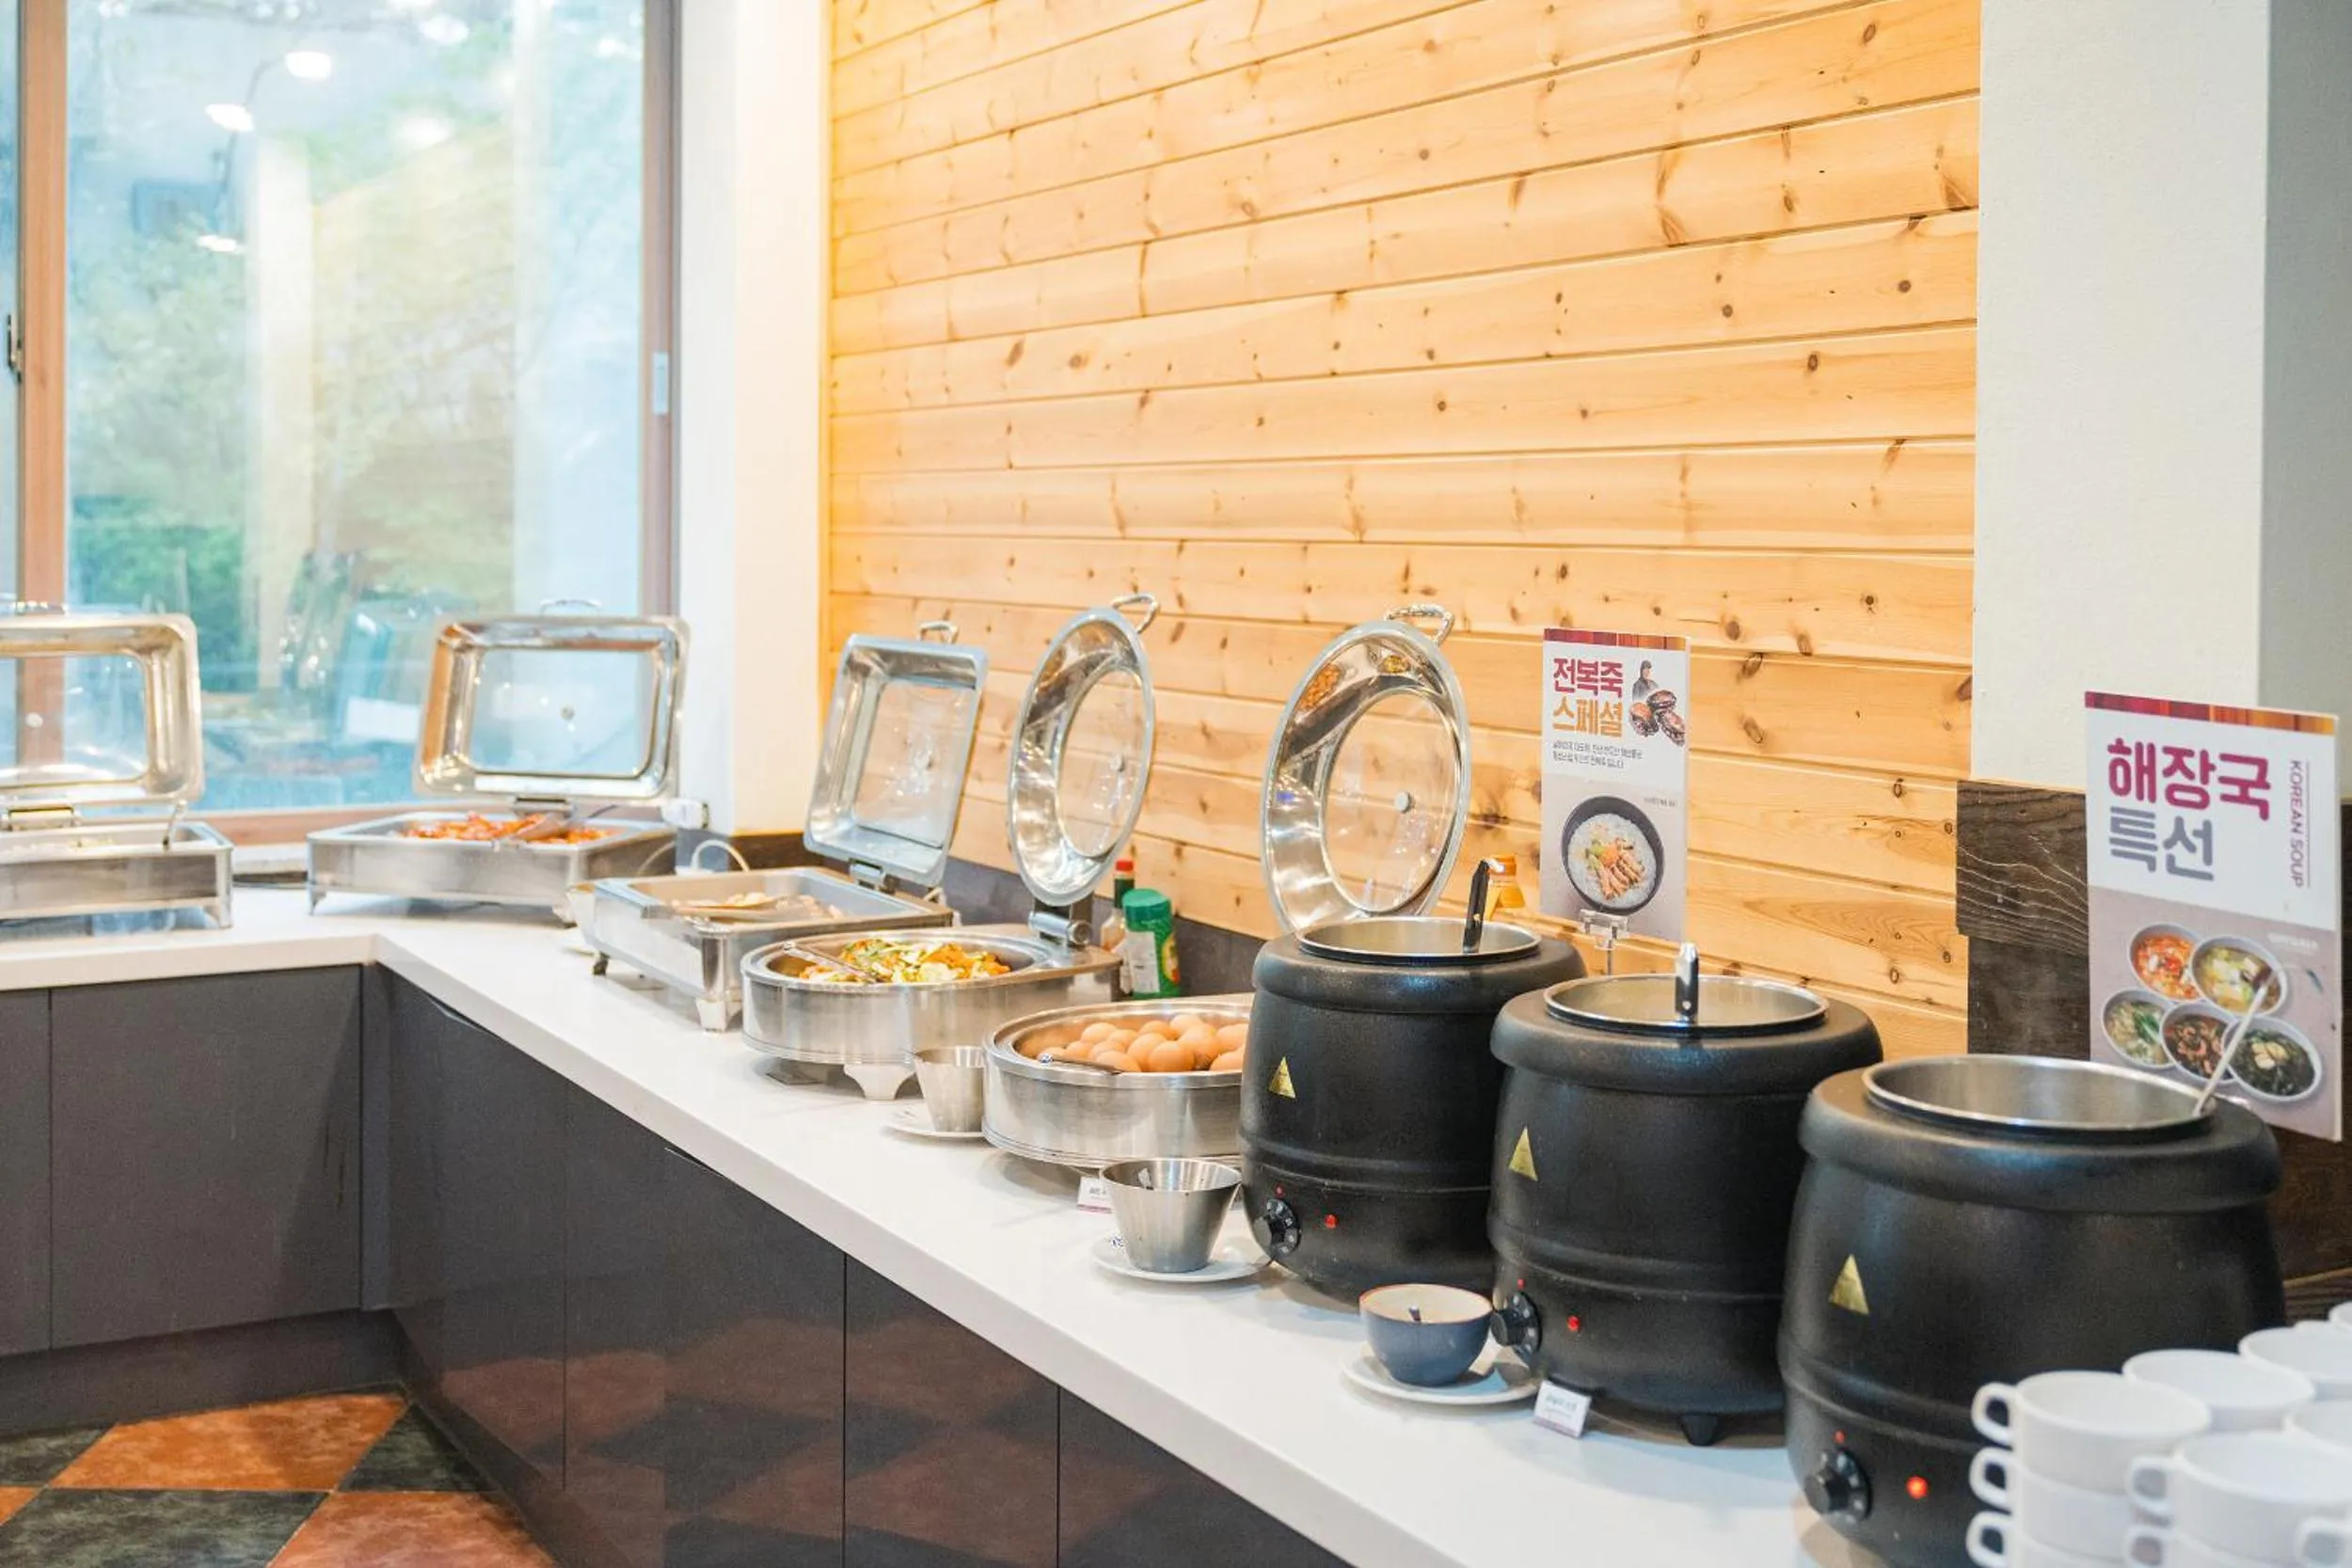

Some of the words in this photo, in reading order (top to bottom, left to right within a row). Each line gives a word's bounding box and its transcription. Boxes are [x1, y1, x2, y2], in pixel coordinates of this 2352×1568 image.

[1553, 657, 1624, 698] 전복죽
[1553, 696, 1623, 737] 스페셜
[2107, 737, 2271, 821] 해장국
[2290, 759, 2304, 834] KOREAN
[2108, 806, 2215, 881] 특선
[2290, 836, 2304, 889] SOUP
